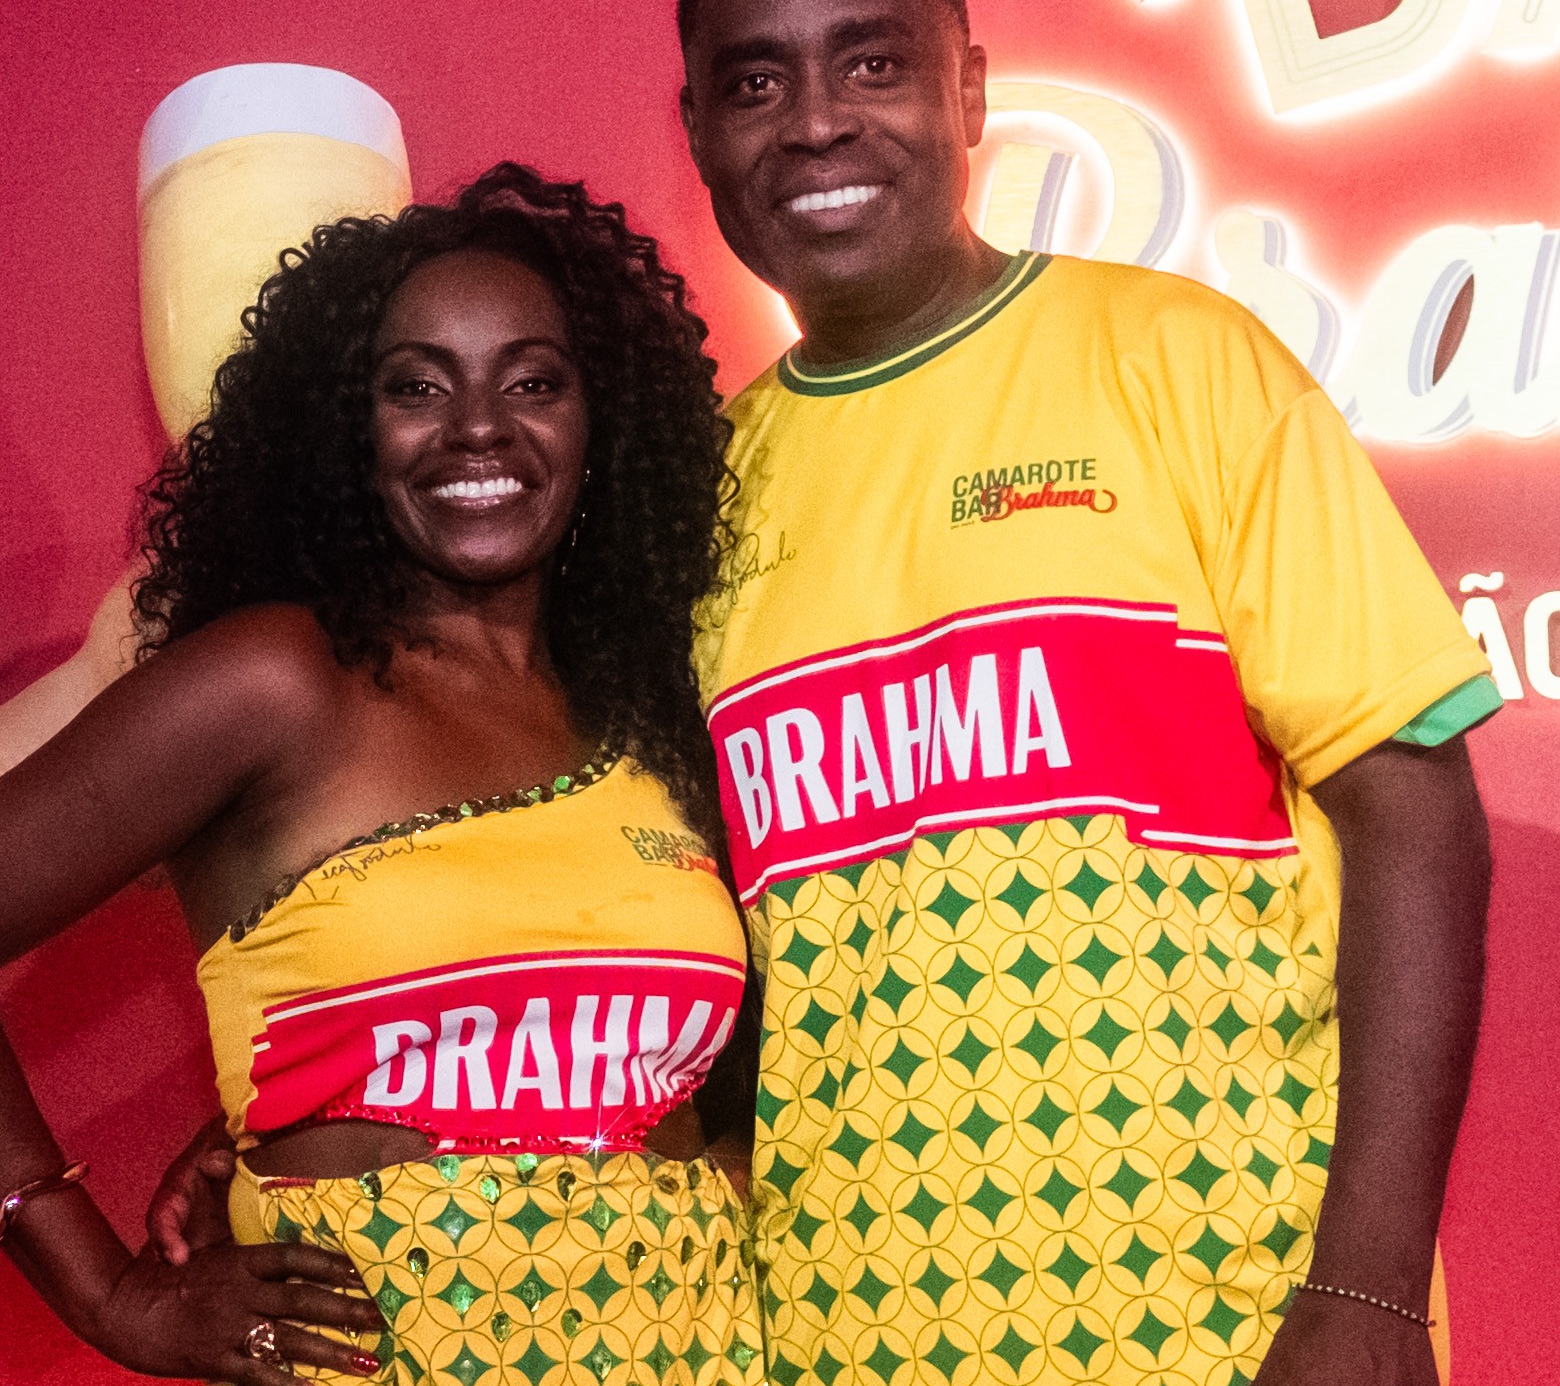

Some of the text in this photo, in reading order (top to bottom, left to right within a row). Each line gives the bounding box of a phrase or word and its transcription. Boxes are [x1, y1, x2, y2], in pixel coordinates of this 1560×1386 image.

[952, 458, 1097, 499] CAMAROTE
[951, 480, 1118, 523] BAR Brahma
[723, 645, 1073, 850] BRAHMA
